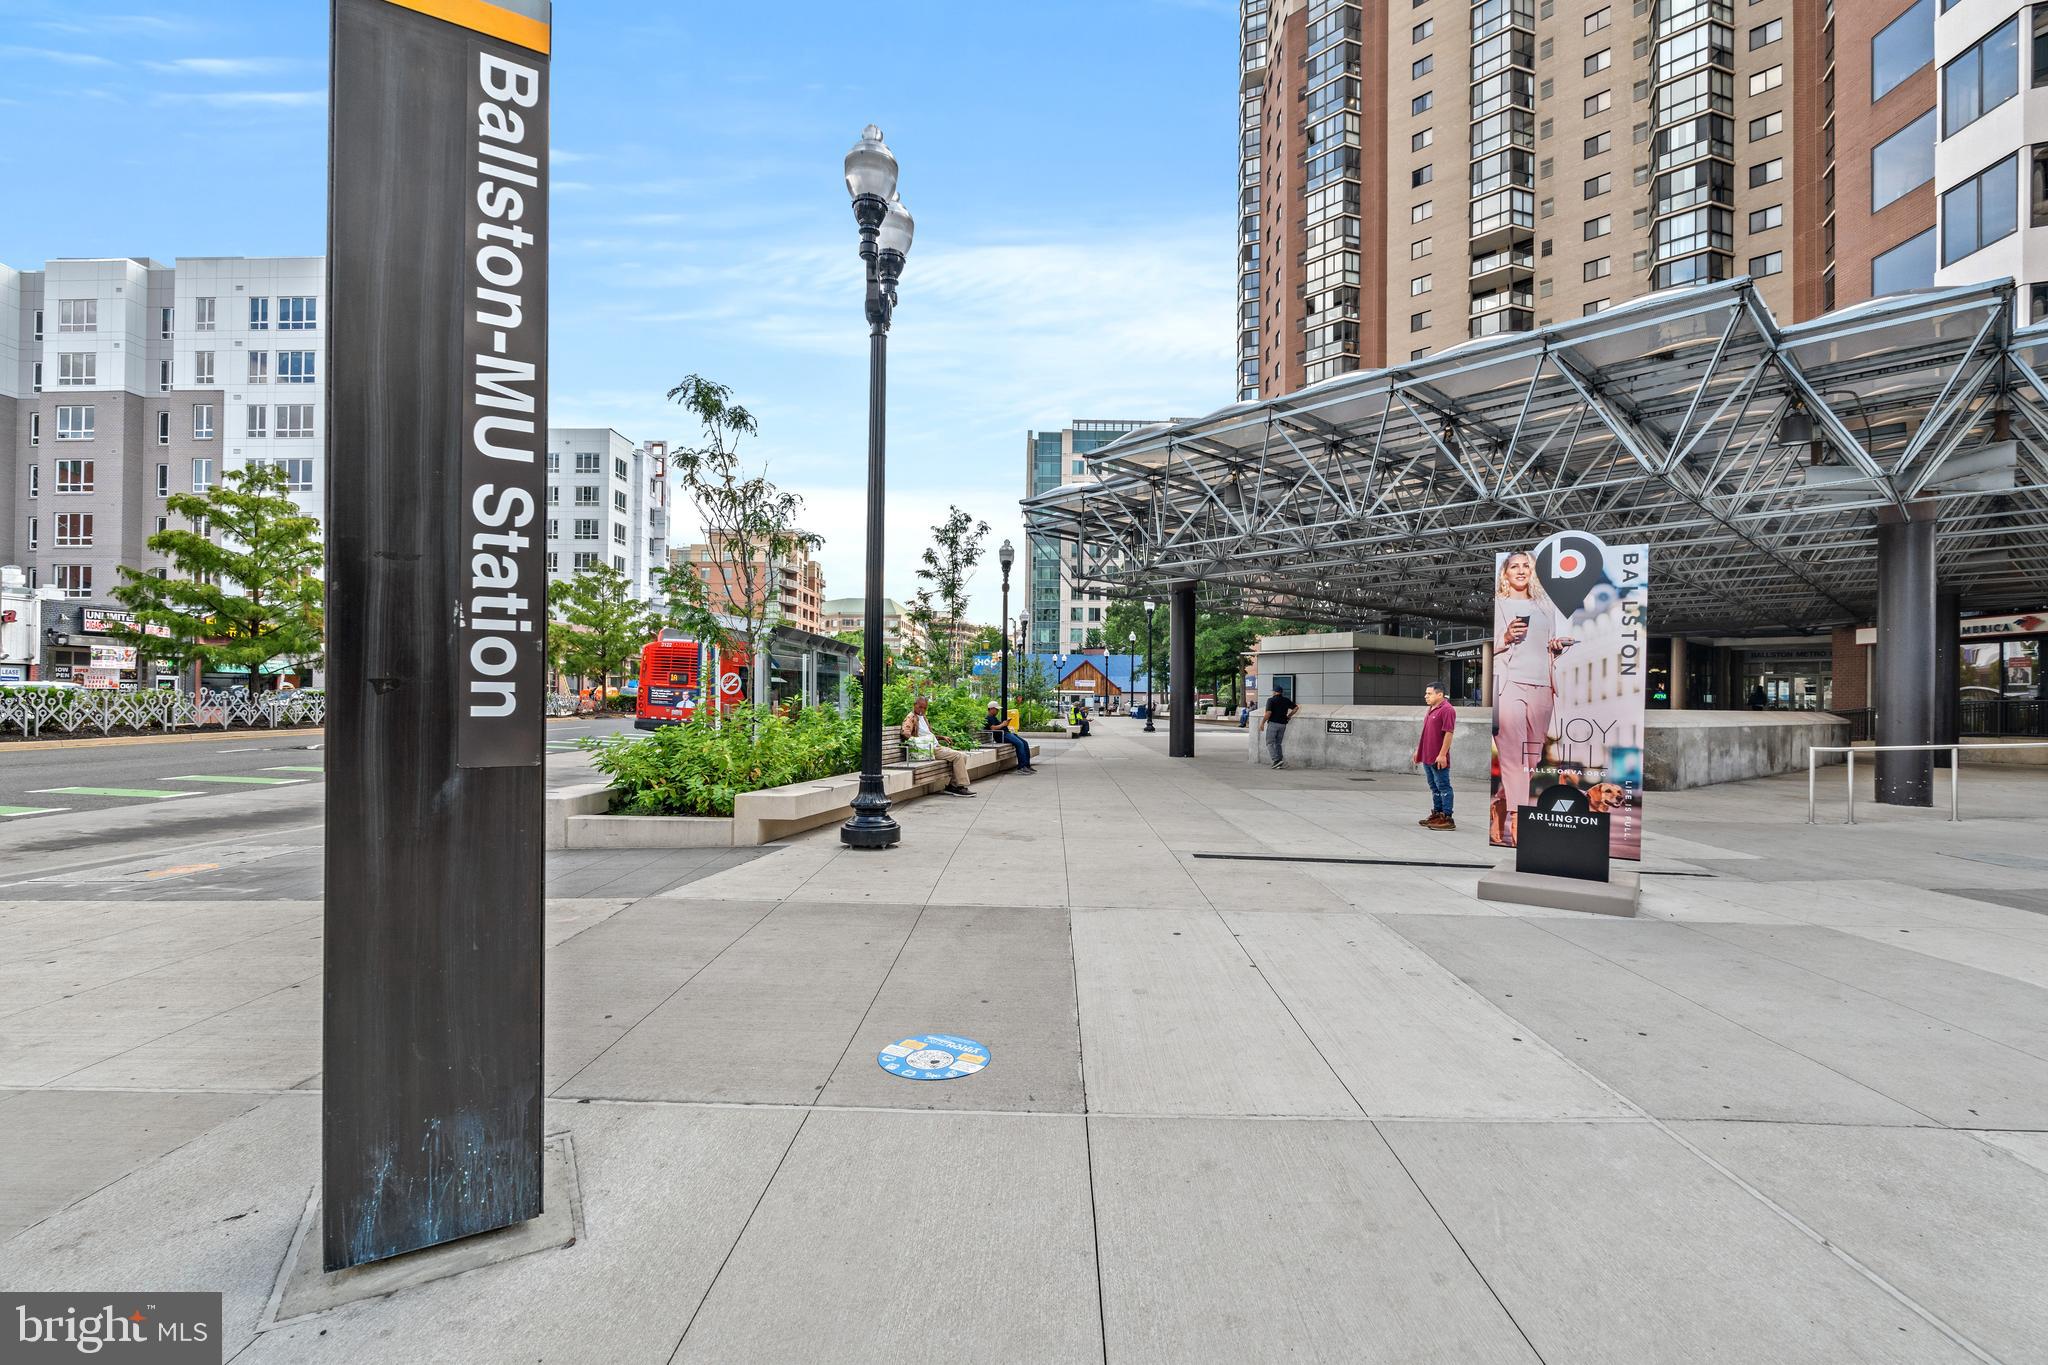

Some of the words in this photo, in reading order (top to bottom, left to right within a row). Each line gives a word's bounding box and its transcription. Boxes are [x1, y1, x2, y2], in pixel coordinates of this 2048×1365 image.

[474, 51, 539, 463] Ballston-MU
[470, 483, 535, 718] Station
[1620, 552, 1639, 676] BALLSTON
[1962, 623, 2010, 635] MERICA
[1546, 718, 1617, 744] JOY
[1522, 741, 1608, 770] FULL
[1523, 766, 1606, 777] BALLSTONVA.ORG
[1528, 812, 1598, 826] ARLINGTON
[1625, 803, 1632, 812] IS
